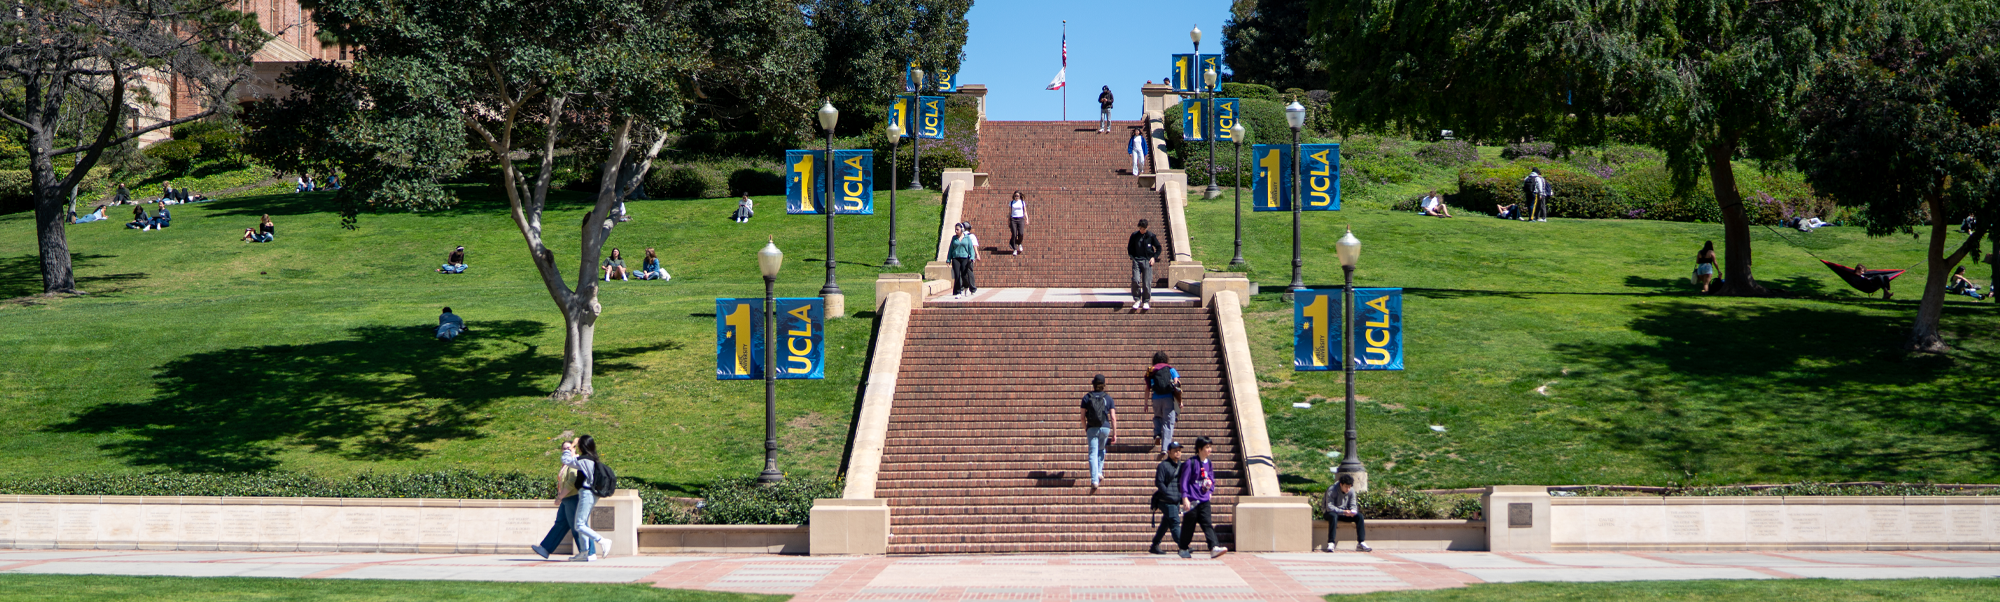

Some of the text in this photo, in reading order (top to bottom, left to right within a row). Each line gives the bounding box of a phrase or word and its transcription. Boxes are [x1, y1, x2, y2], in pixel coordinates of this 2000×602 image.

[939, 69, 951, 90] UCL
[925, 100, 939, 136] UCLA
[1219, 101, 1233, 139] UCLA
[793, 154, 814, 211] #1
[843, 154, 863, 211] UCLA
[1260, 149, 1280, 207] #1
[1309, 149, 1330, 206] UCLA
[726, 304, 751, 376] #1
[787, 304, 813, 375] UCLA
[1303, 294, 1328, 367] #1
[1365, 295, 1390, 365] UCLA
